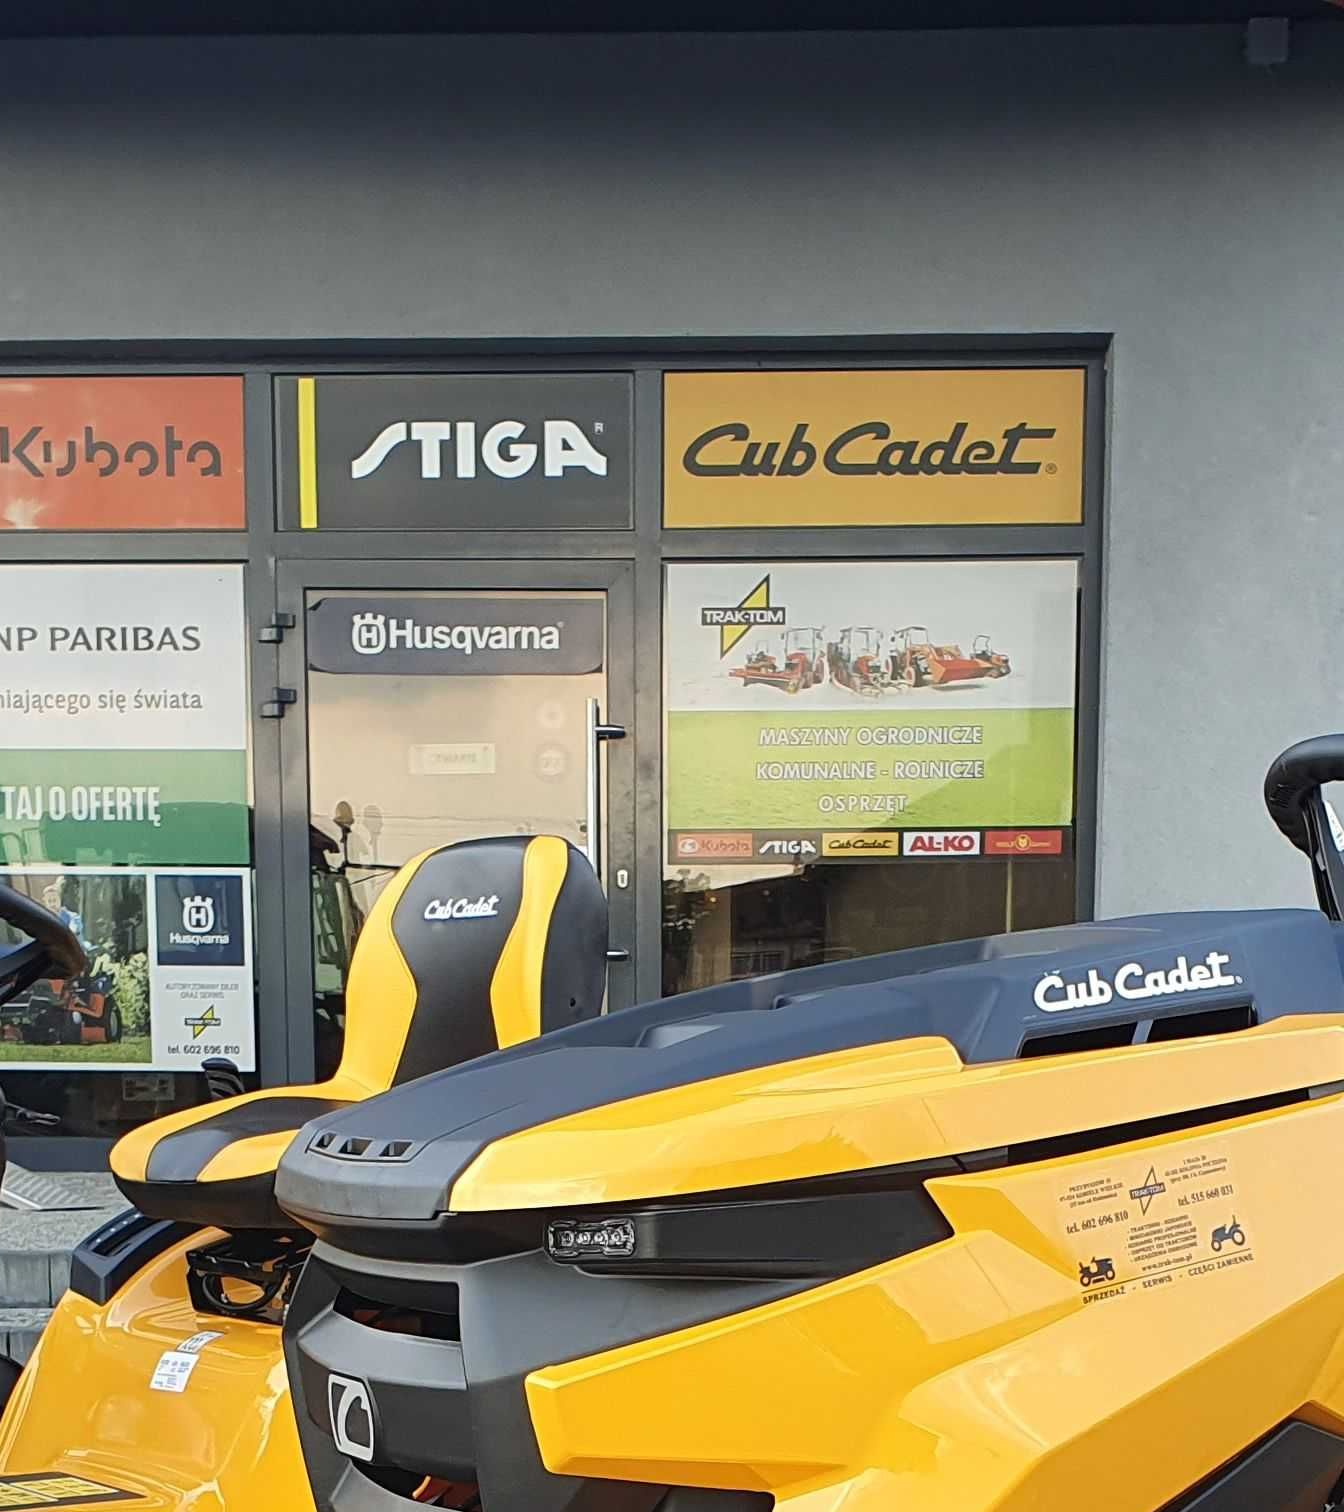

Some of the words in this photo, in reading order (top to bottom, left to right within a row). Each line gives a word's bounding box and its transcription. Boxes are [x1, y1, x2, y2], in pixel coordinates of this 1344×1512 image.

[351, 420, 608, 479] STIGA
[682, 422, 818, 477] Cub
[823, 420, 1056, 476] Cadet
[49, 625, 201, 652] PARIBAS
[389, 618, 560, 655] Husqvarna
[97, 689, 126, 713] się
[133, 688, 203, 709] świata
[758, 727, 851, 746] MASZYNY
[856, 725, 984, 745] OGRODNICZE
[756, 760, 877, 780] KOMUNALNE
[893, 760, 985, 779] ROLNICZE
[48, 785, 66, 821] O
[71, 785, 162, 827] OFERTĘ
[818, 794, 907, 817] OSPRZĘT
[759, 840, 816, 855] STIGA
[909, 835, 974, 853] AL-KO
[452, 895, 500, 918] Cadet
[169, 932, 230, 946] Husqvarna
[1033, 968, 1113, 1012] Cub
[1114, 951, 1236, 1000] Cadet
